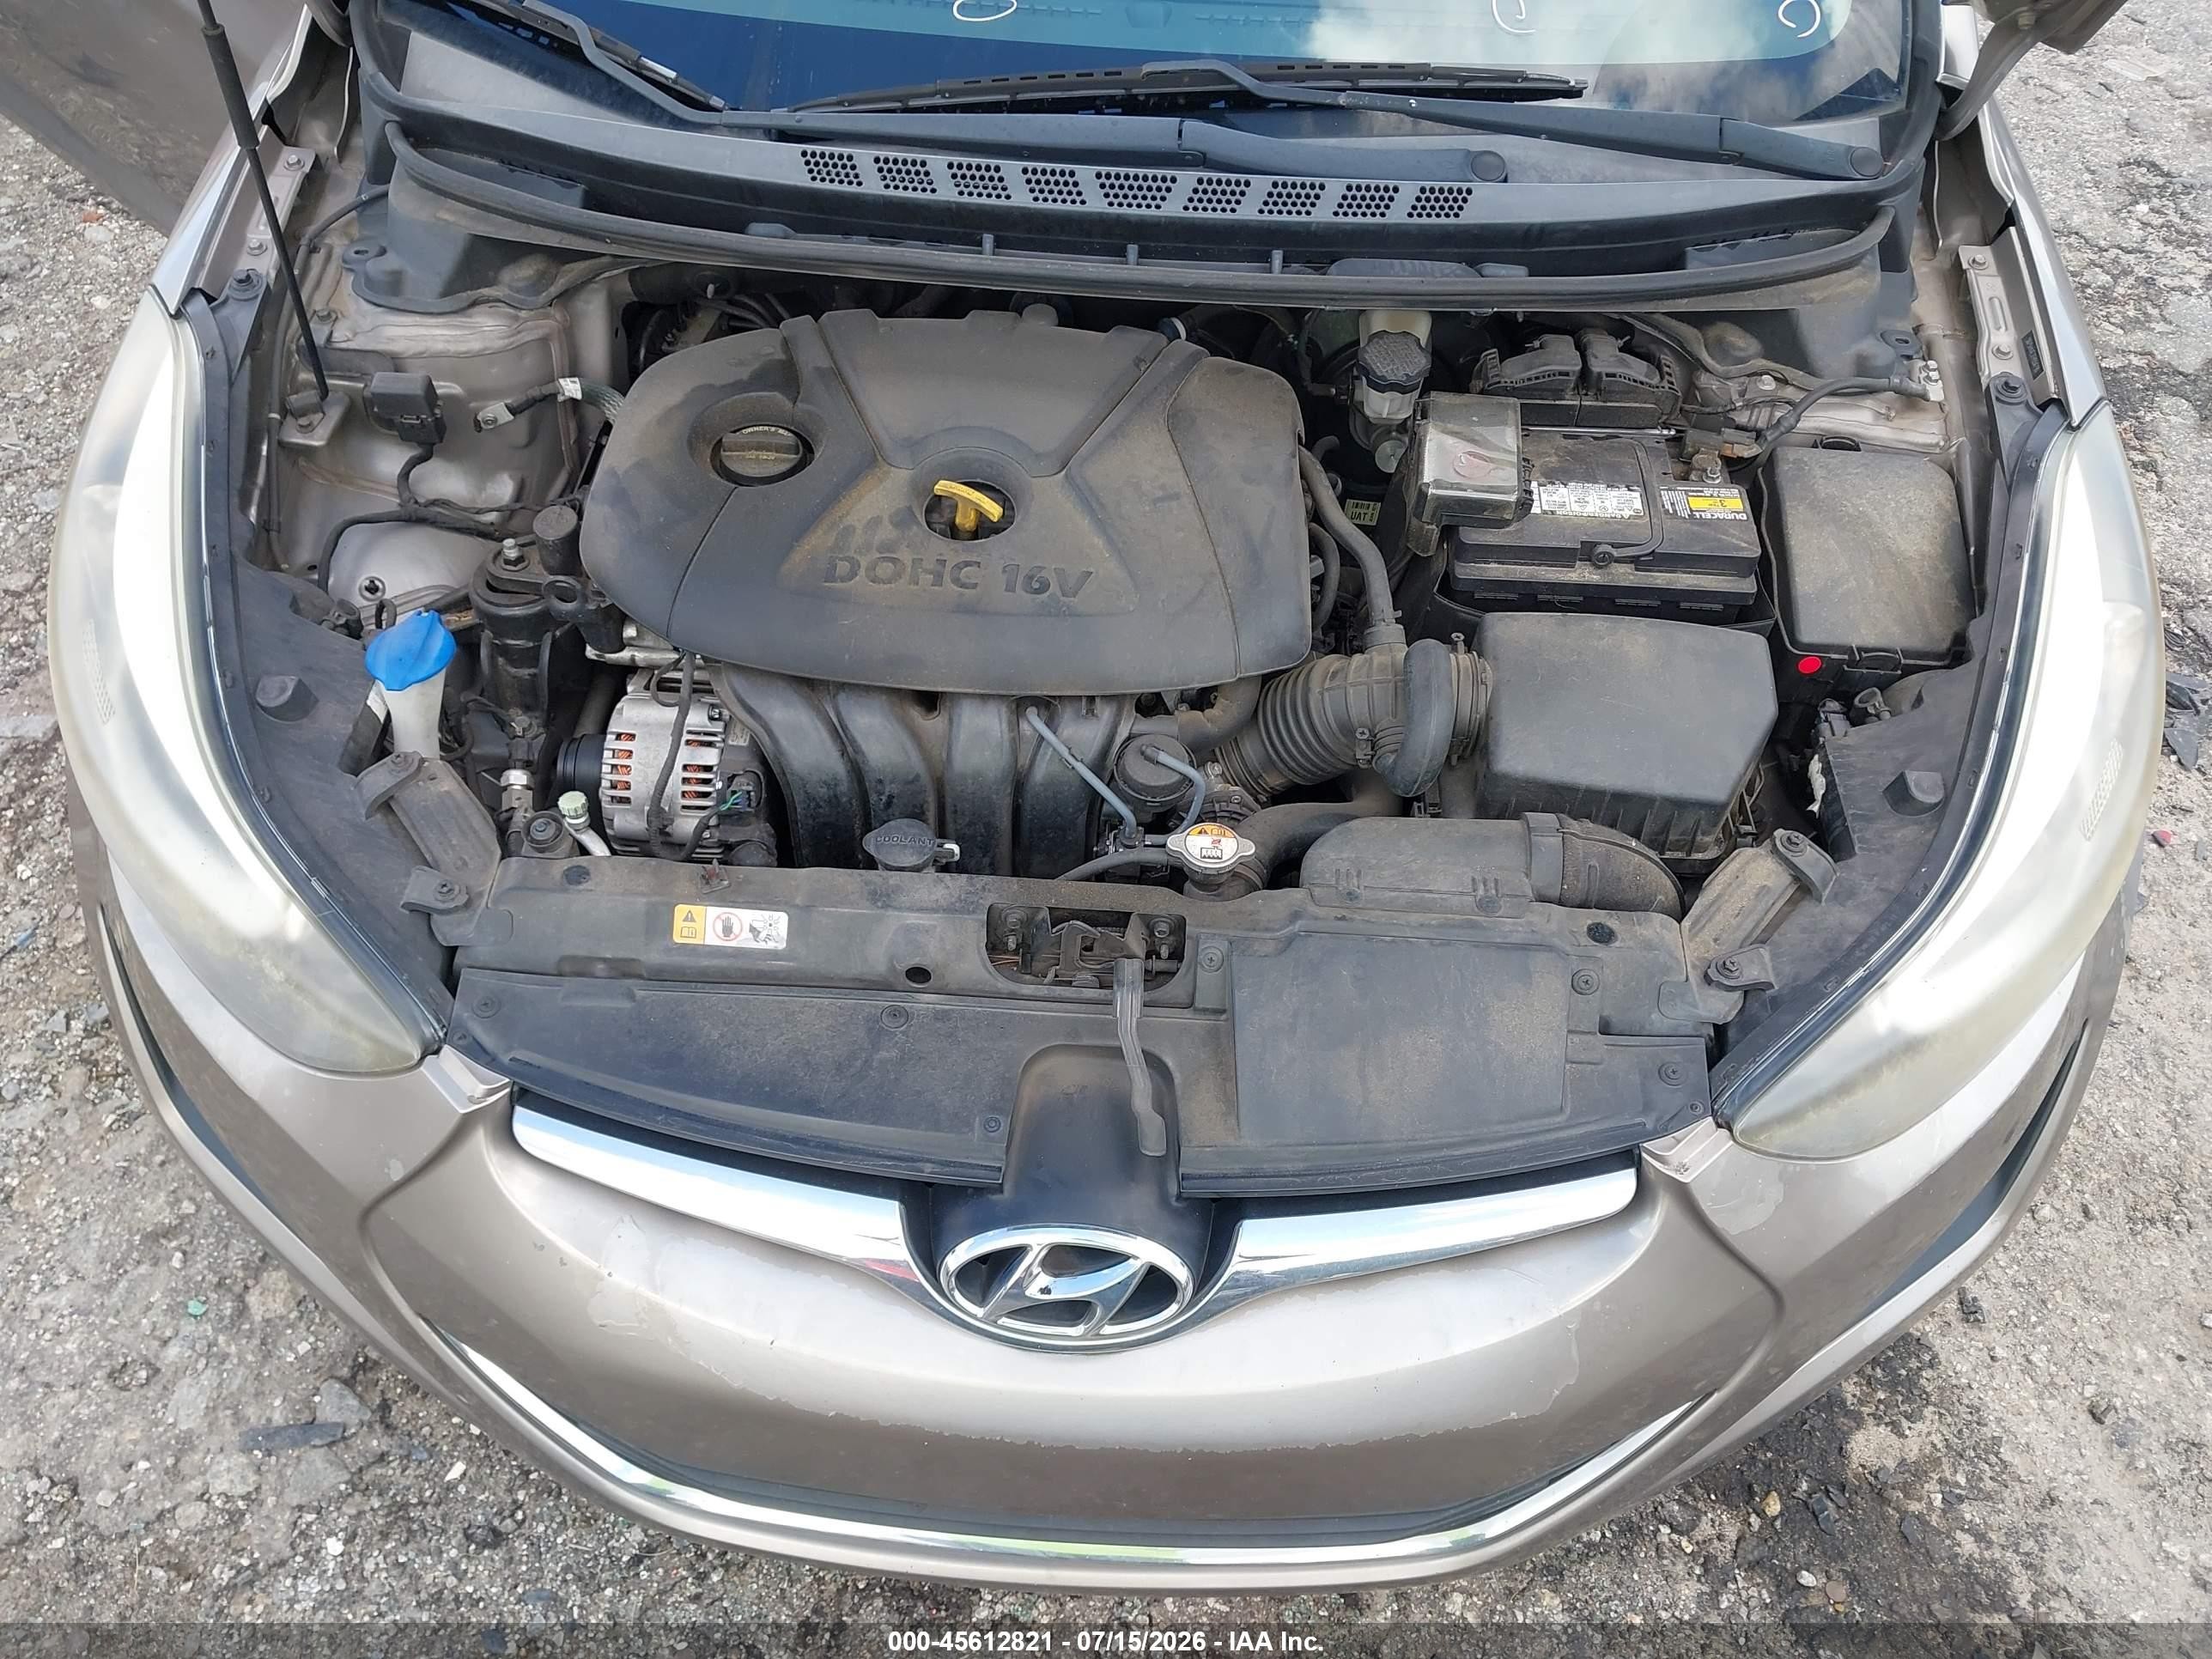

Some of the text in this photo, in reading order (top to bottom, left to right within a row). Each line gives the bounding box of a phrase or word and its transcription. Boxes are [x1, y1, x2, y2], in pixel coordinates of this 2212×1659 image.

[1693, 512, 1747, 520] DURACELL
[823, 556, 1093, 599] DOHC 16V
[876, 835, 934, 846] COOLANT
